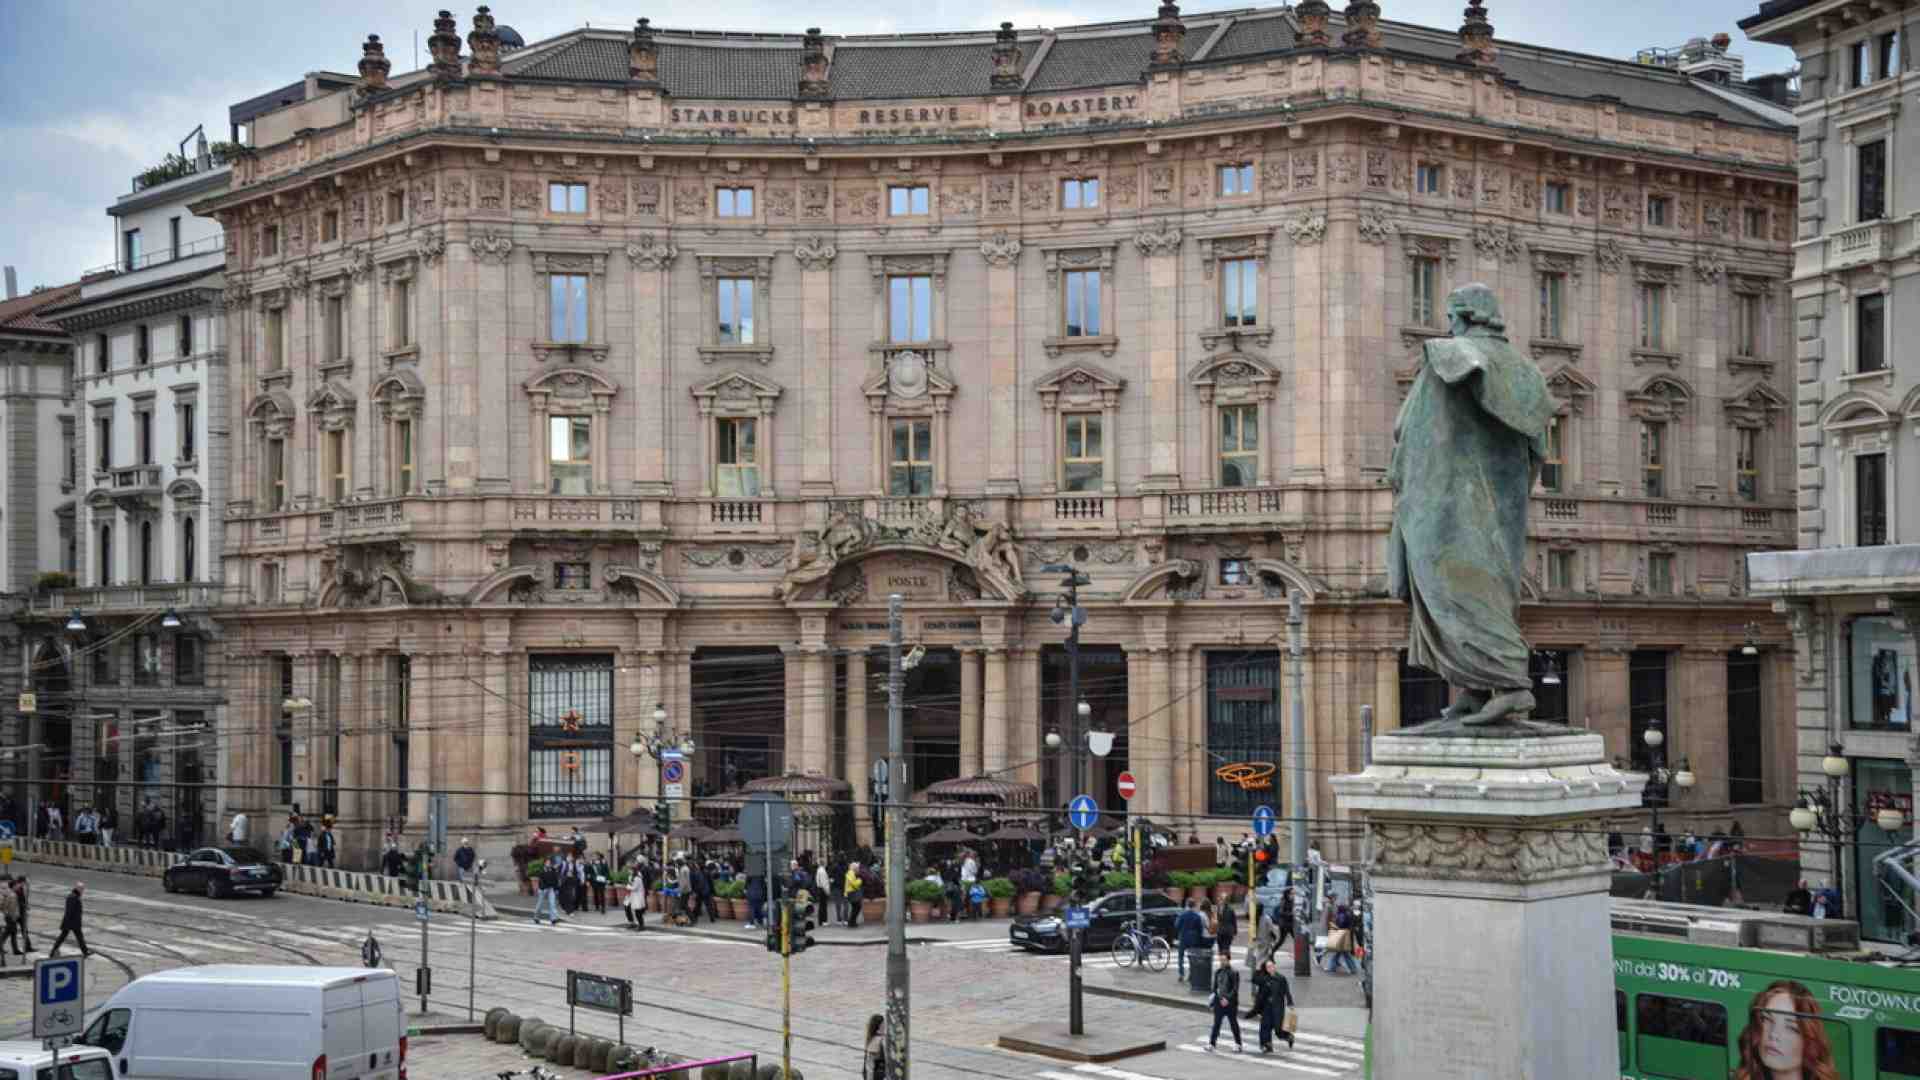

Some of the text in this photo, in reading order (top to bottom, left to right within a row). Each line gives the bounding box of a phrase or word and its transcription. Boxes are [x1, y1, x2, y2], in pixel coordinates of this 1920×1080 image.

[672, 95, 1137, 125] STARBUCKS RESERVE ROASTERY
[888, 575, 929, 586] POSTE
[48, 967, 73, 1000] P
[1635, 961, 1656, 977] dal
[1657, 962, 1690, 982] 30%
[1692, 968, 1705, 984] al
[1708, 969, 1742, 988] 70%
